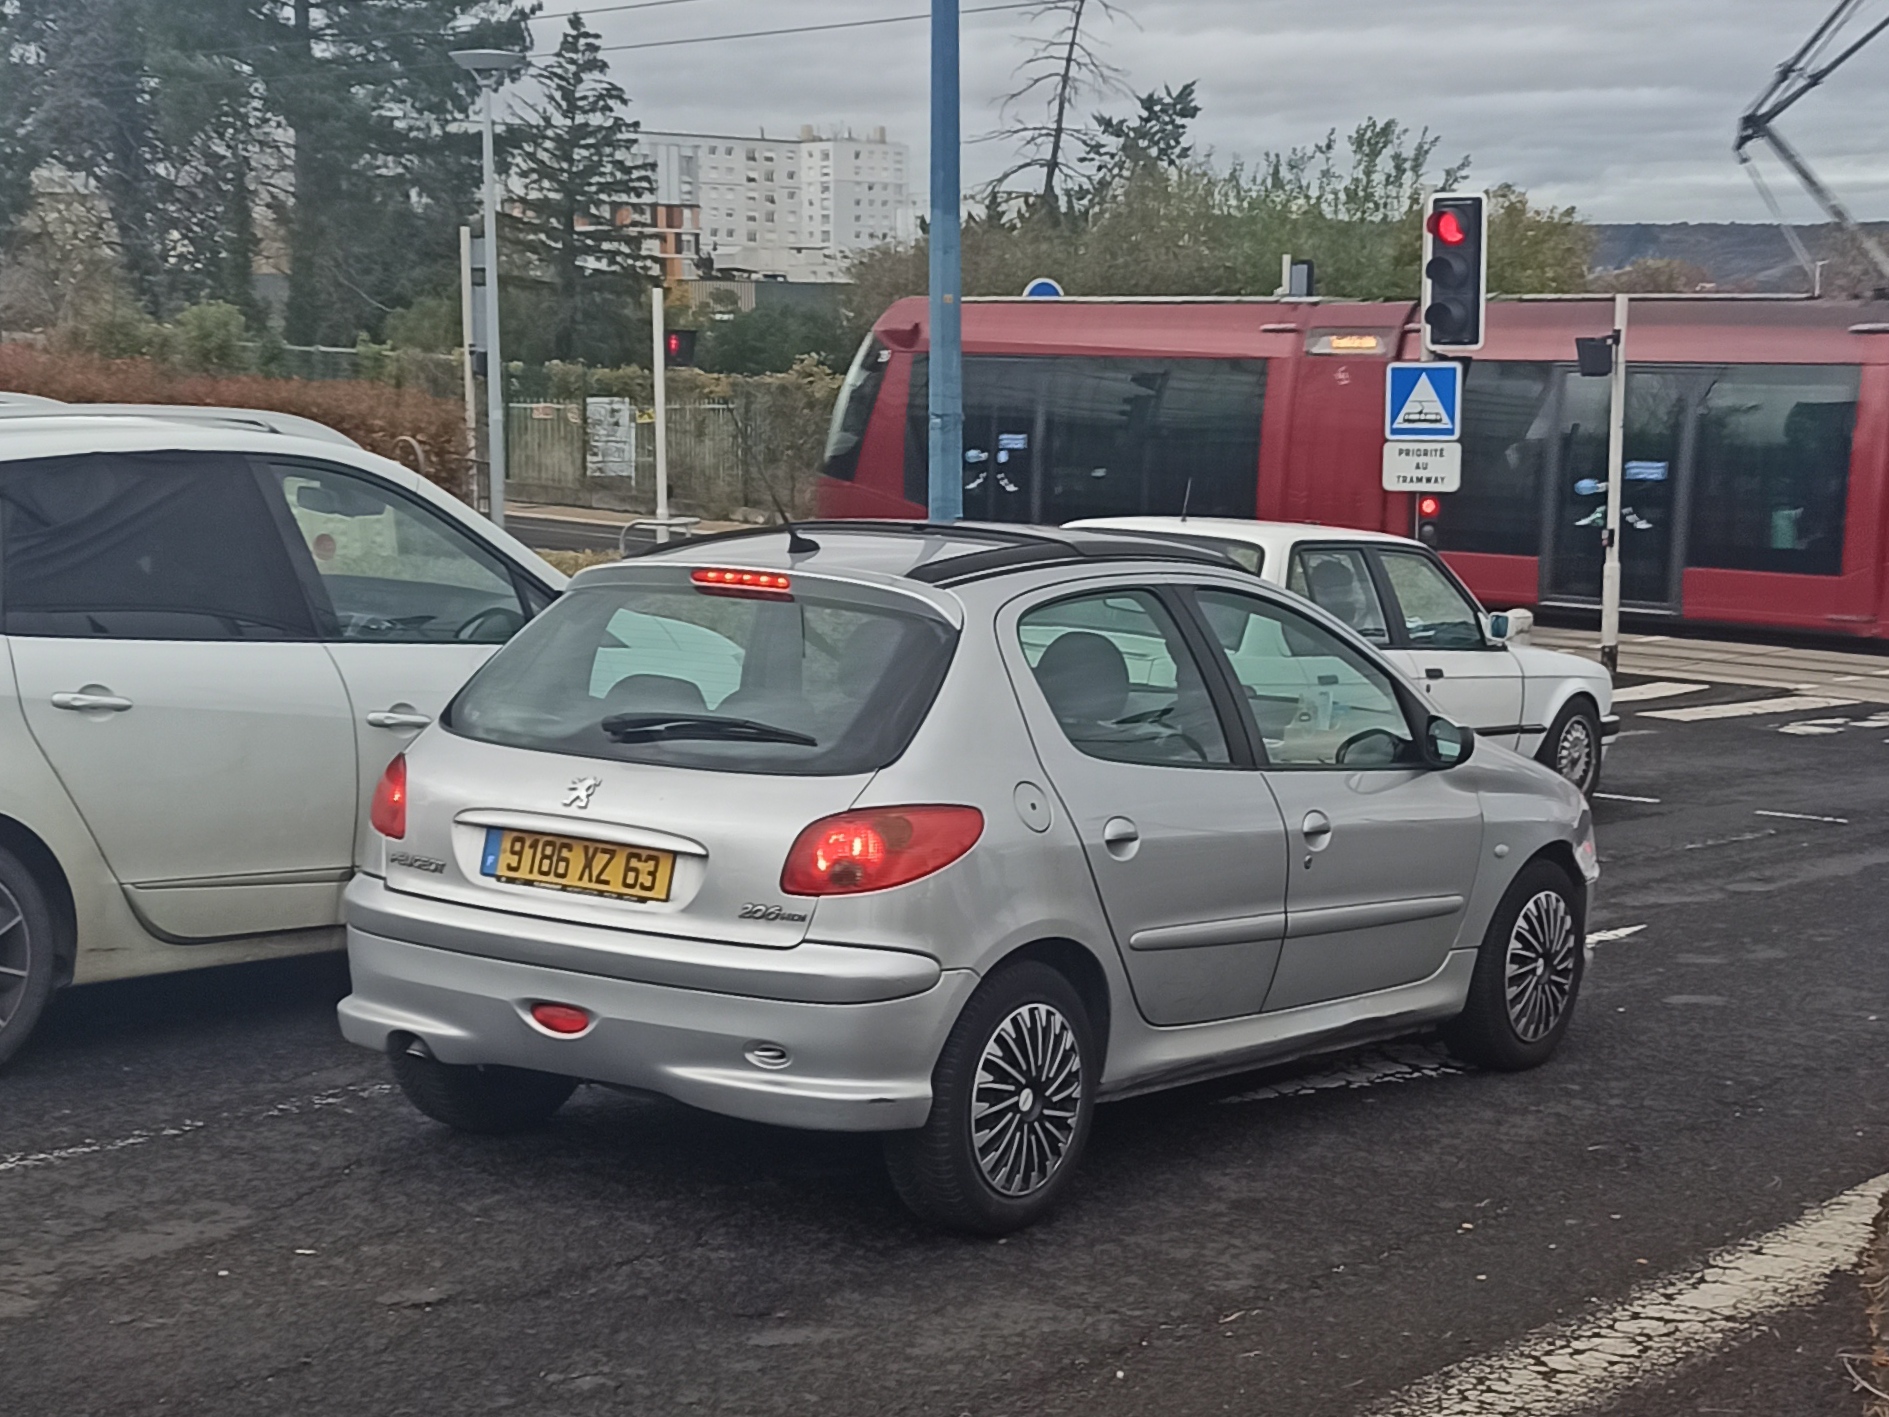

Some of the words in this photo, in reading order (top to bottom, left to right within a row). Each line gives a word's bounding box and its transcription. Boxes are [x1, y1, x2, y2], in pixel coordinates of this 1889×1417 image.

[1398, 447, 1445, 458] PRIORITÉ
[1415, 461, 1429, 470] AU
[1396, 475, 1446, 484] TRAMWAY
[485, 855, 496, 866] F
[506, 836, 573, 879] 9186
[578, 845, 617, 886] XZ
[622, 851, 661, 892] 63
[738, 902, 782, 921] 206
